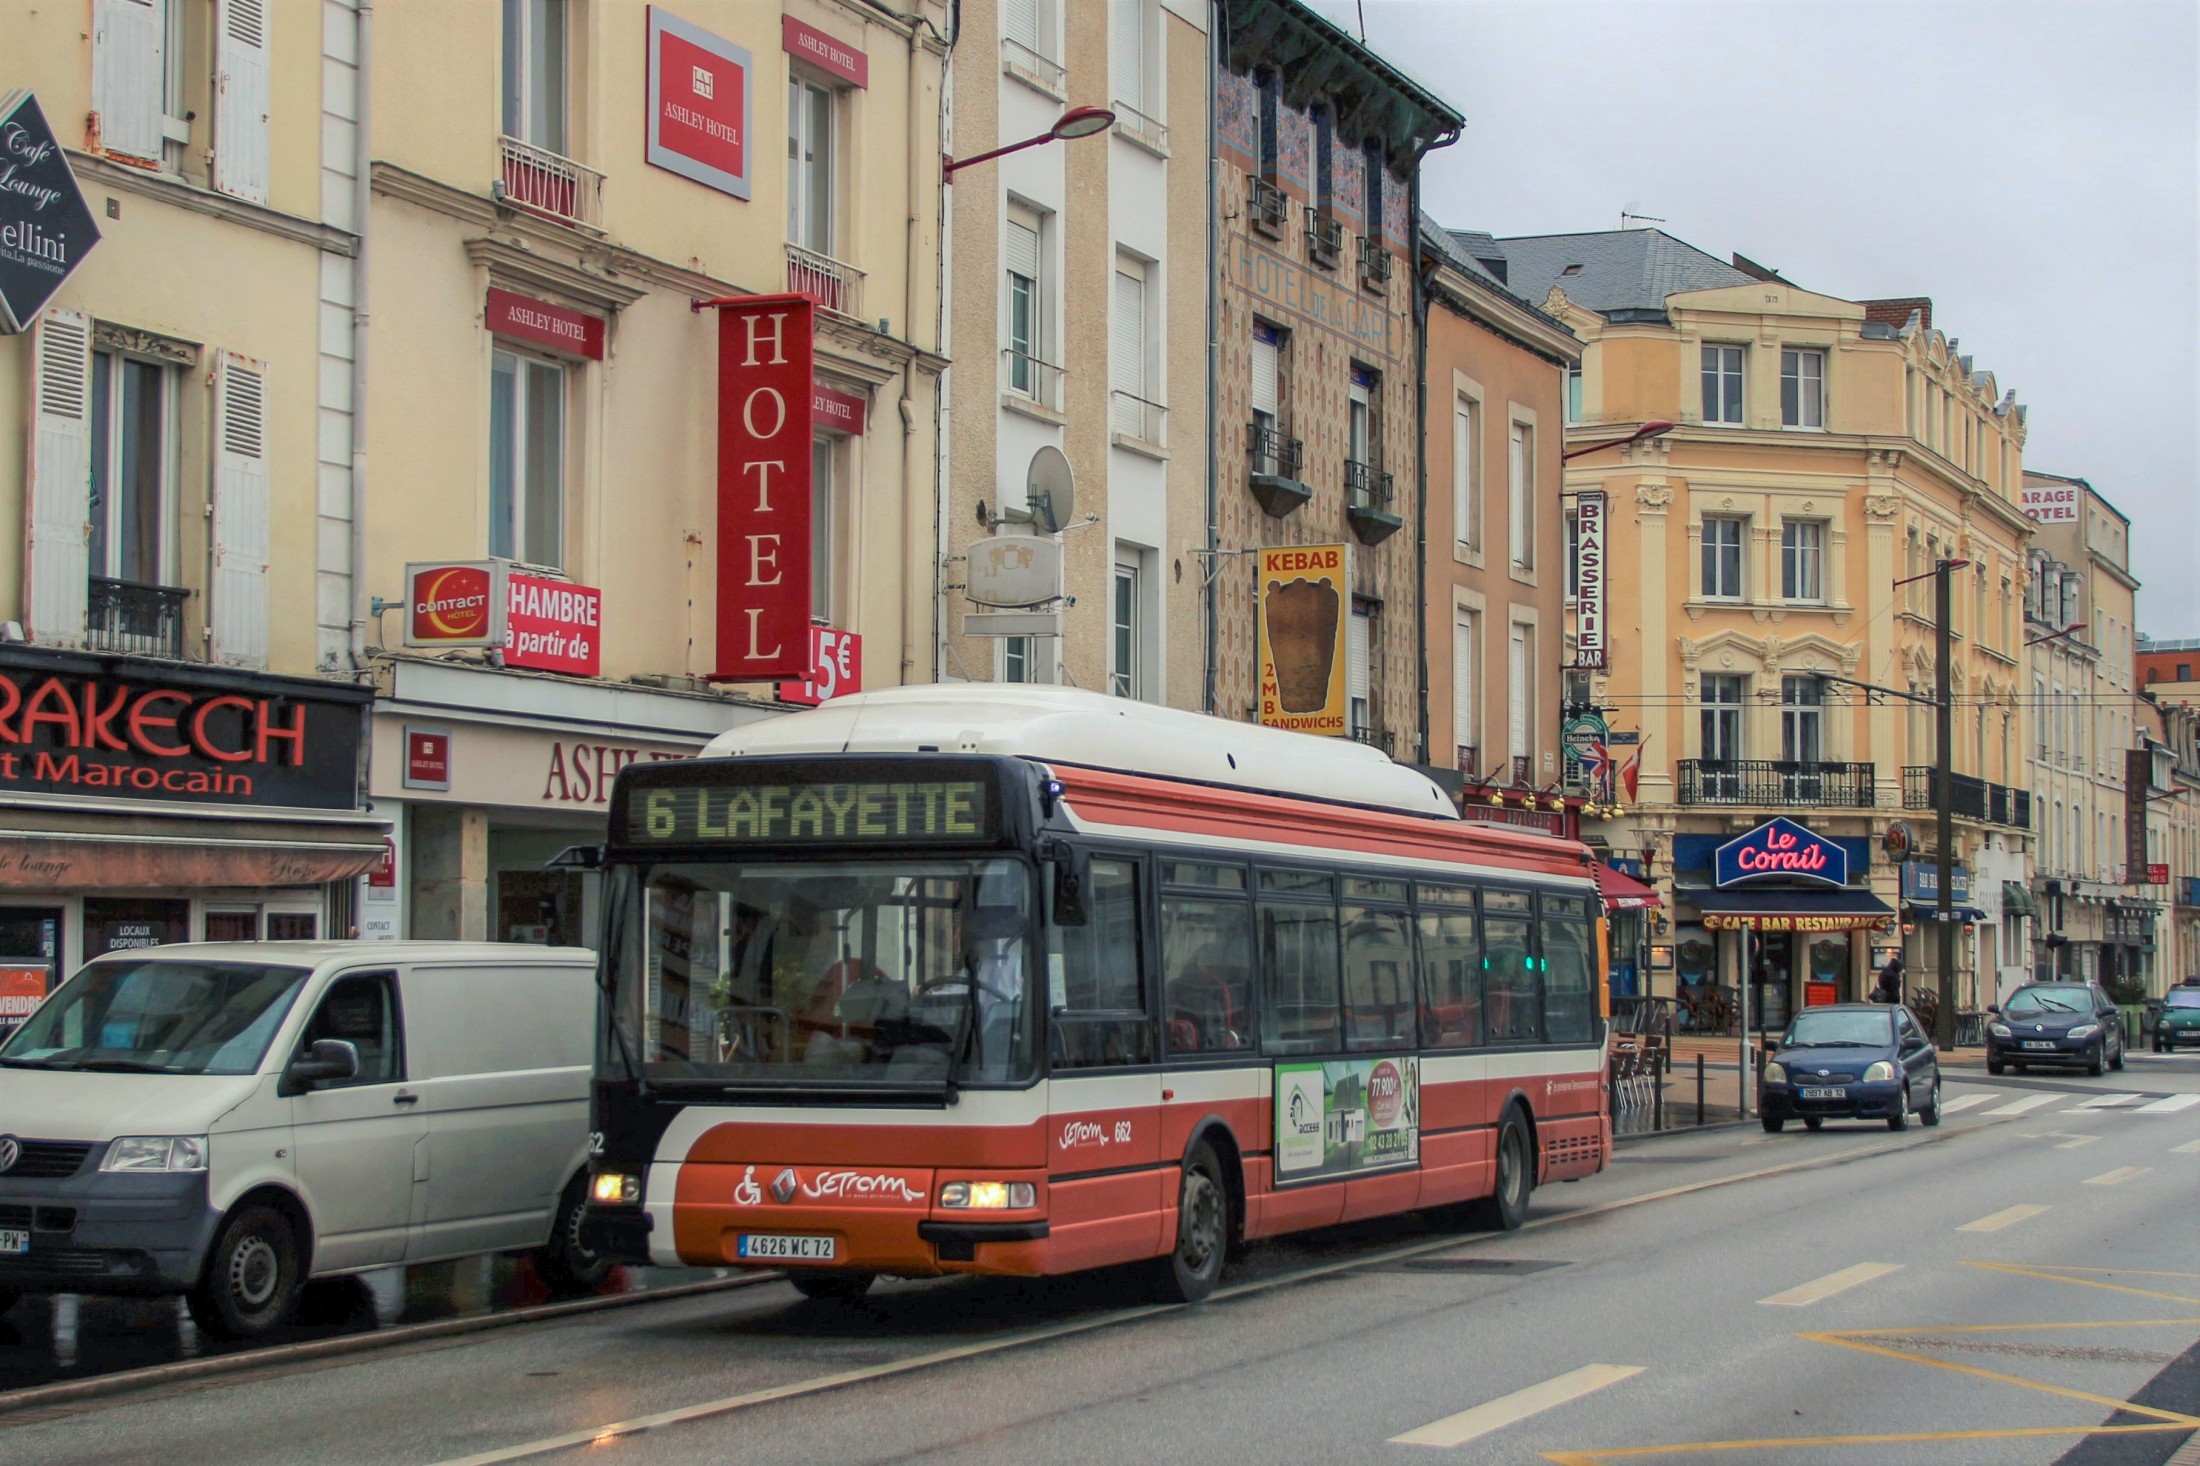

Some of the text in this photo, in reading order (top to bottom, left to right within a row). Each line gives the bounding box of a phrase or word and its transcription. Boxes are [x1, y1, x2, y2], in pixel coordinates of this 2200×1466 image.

[799, 33, 855, 72] ASHLEY HOTEL
[665, 102, 739, 145] ASHLEY HOTEL
[5, 121, 55, 167] Café
[0, 220, 66, 264] ellini
[27, 256, 65, 275] passione
[1239, 243, 1312, 315] HOTEL
[508, 306, 587, 341] ASHLEY HOTEL
[812, 396, 851, 419] EY HOTEL
[741, 313, 789, 660] HOTEL
[1266, 551, 1339, 572] KEBAB
[1580, 504, 1600, 647] BRASSERIE
[507, 582, 597, 627] HAMBRE
[518, 630, 567, 657] partir
[569, 633, 589, 660] de
[1578, 651, 1602, 667] BAR
[805, 629, 851, 700] 5€
[1566, 735, 1600, 743] Heineke
[35, 751, 253, 796] Marocain
[543, 742, 696, 803] ASH
[647, 782, 975, 838] 6 LAFAYETTE
[1767, 827, 1797, 849] Le
[1738, 843, 1827, 870] Corail
[119, 926, 150, 936] LOCAUX
[1761, 917, 1790, 930] BAR
[1795, 916, 1876, 931] RESTAURANT
[110, 938, 159, 949] DISPONIBLES
[1115, 1121, 1131, 1142] 662
[751, 1237, 831, 1257] 4626 WC 72
